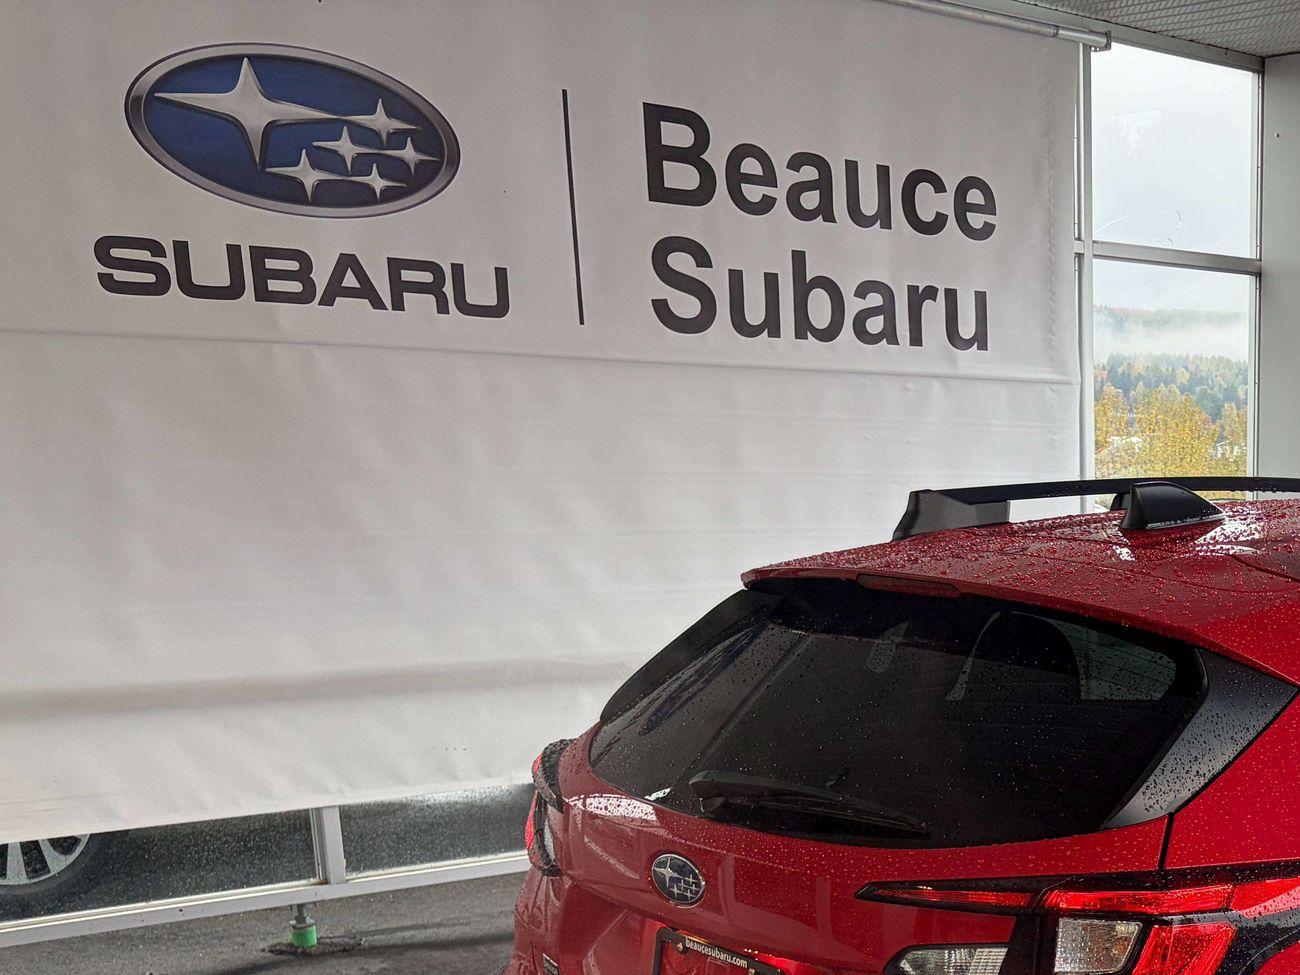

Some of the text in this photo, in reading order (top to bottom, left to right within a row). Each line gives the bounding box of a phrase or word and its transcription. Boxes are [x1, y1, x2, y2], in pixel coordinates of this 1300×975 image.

[643, 102, 997, 242] Beauce
[93, 235, 510, 319] SUBARU
[650, 236, 991, 351] Subaru
[685, 937, 748, 969] beaucesubaru.com
